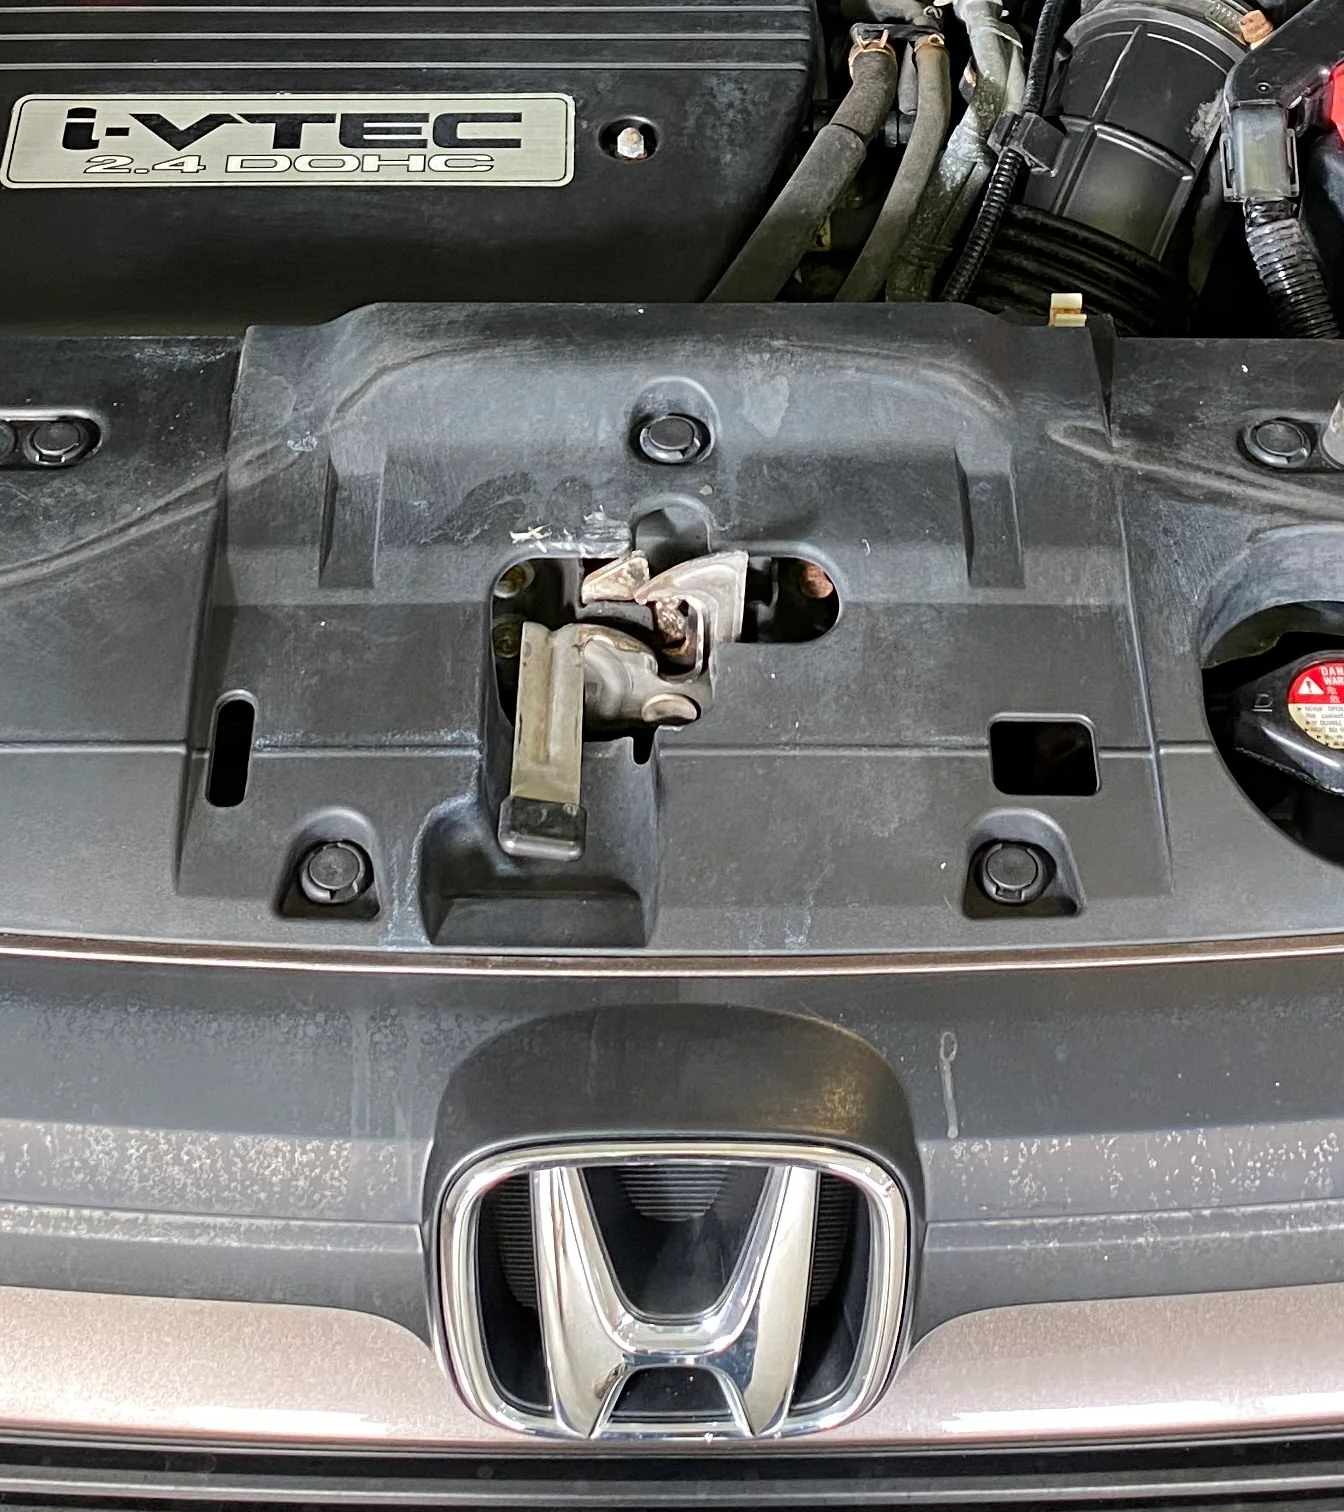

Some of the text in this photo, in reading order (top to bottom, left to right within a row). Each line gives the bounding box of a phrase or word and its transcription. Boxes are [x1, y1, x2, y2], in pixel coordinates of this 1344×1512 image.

[61, 107, 523, 152] i-VTEC
[84, 153, 495, 174] 2.4 DOHC
